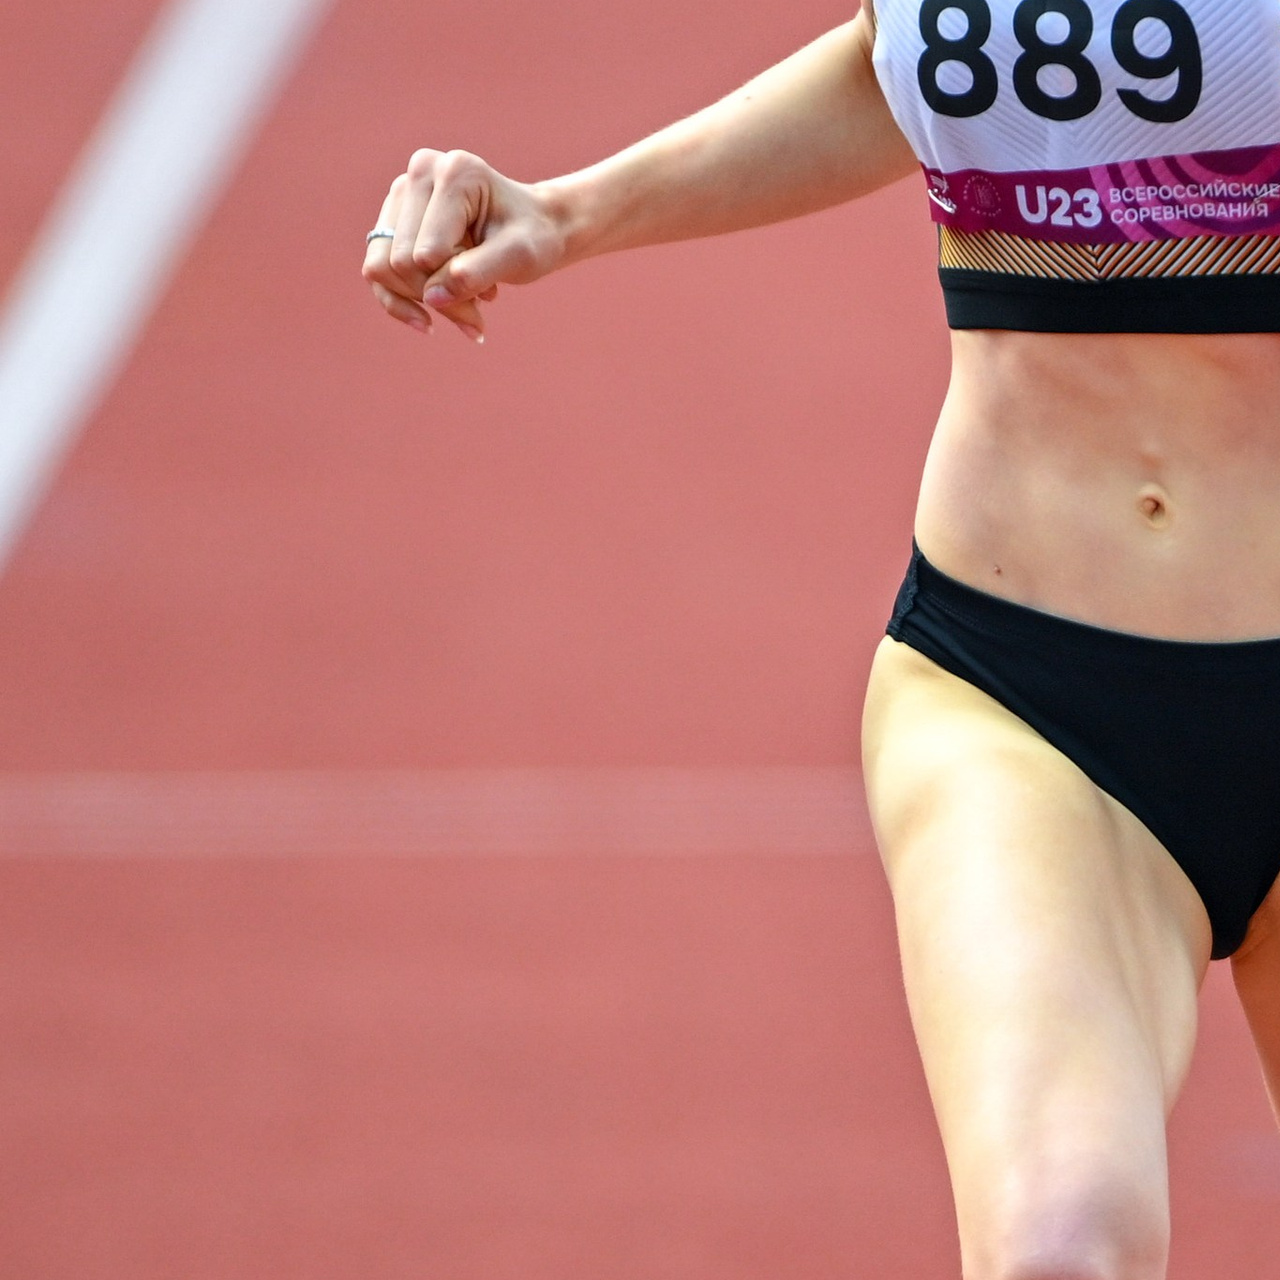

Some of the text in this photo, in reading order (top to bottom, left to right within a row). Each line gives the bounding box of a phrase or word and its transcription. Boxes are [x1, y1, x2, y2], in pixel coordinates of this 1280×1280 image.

[1108, 179, 1280, 203] ВСЕРОССИЙСКИЕ
[1014, 184, 1102, 227] U23
[1110, 202, 1269, 225] СОРЕВНОВАНИЯ
